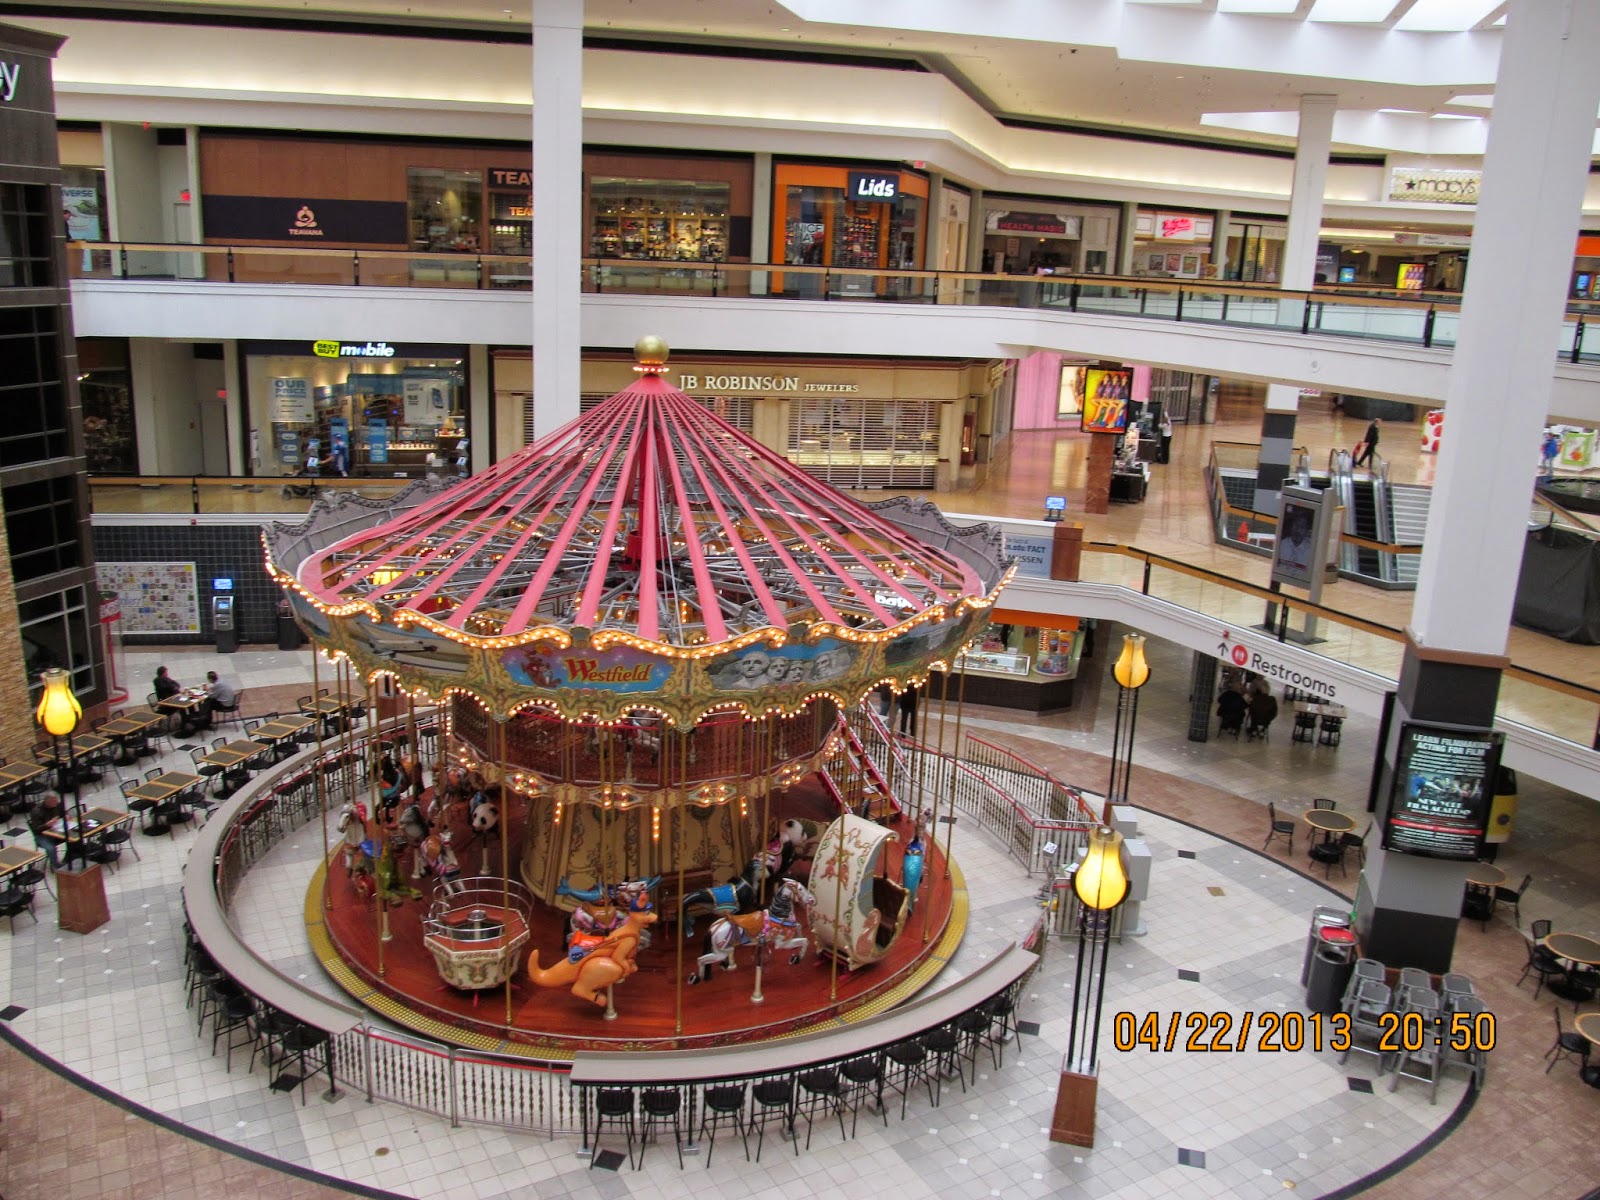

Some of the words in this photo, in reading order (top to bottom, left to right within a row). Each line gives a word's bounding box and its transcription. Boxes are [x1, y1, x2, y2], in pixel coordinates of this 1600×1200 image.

[63, 189, 94, 197] VERSE
[858, 178, 895, 197] Lids
[288, 228, 324, 236] TEAVANA
[1000, 222, 1034, 231] HEALTH
[340, 342, 395, 357] mobile
[275, 380, 306, 388] OUR
[679, 375, 698, 392] JB
[705, 376, 799, 391] ROBINSON
[804, 384, 859, 392] JEWELERS
[1027, 545, 1046, 553] FACT
[565, 658, 653, 682] Westfield
[1252, 653, 1336, 697] Restrooms
[1413, 734, 1440, 744] LEARN
[1441, 738, 1491, 749] FILMMAKING
[1416, 742, 1447, 752] ACTING
[1447, 746, 1465, 755] FOR
[1465, 748, 1486, 756] FILM
[1406, 802, 1430, 810] FILM
[1417, 798, 1439, 806] NEW
